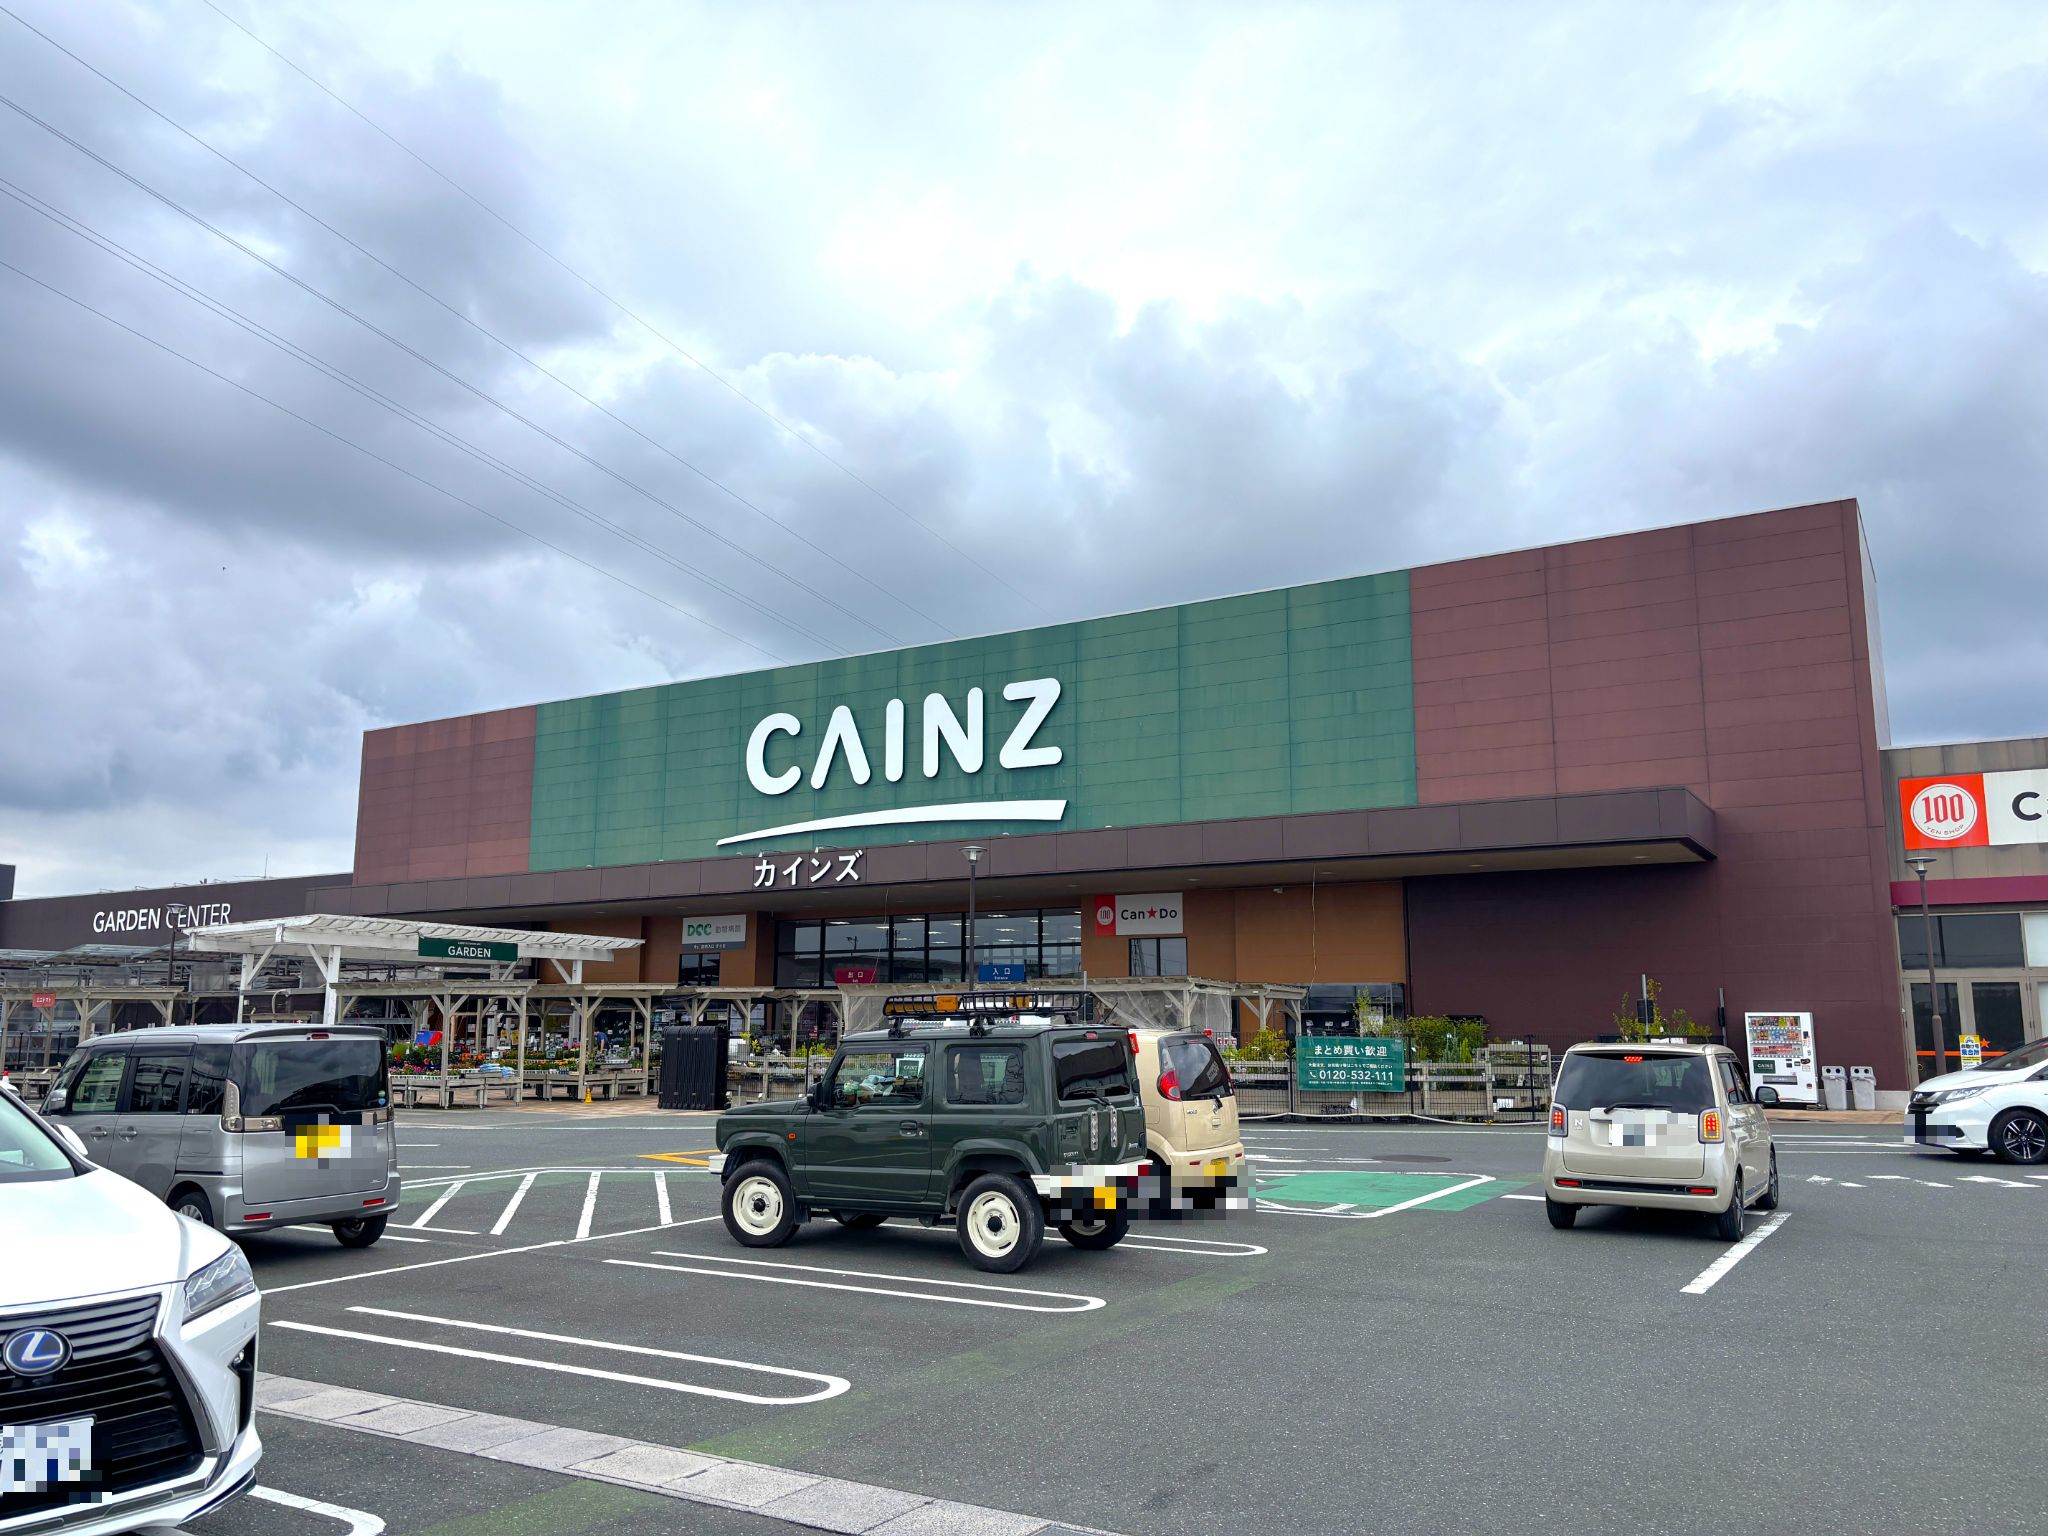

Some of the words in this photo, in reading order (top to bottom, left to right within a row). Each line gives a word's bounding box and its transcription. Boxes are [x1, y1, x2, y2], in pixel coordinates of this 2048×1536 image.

[746, 677, 1063, 795] CAINZ
[1922, 793, 1965, 824] 100
[2012, 791, 2048, 821] C
[1926, 825, 1942, 836] YEN
[1943, 824, 1965, 836] SHOP
[754, 849, 864, 888] カインズ
[93, 908, 161, 933] GARDEN
[1100, 909, 1111, 920] 100
[448, 946, 491, 958] GARDEN
[1314, 1044, 1388, 1057] まとめ買い歓迎
[1319, 1070, 1393, 1081] 0120-532-111
